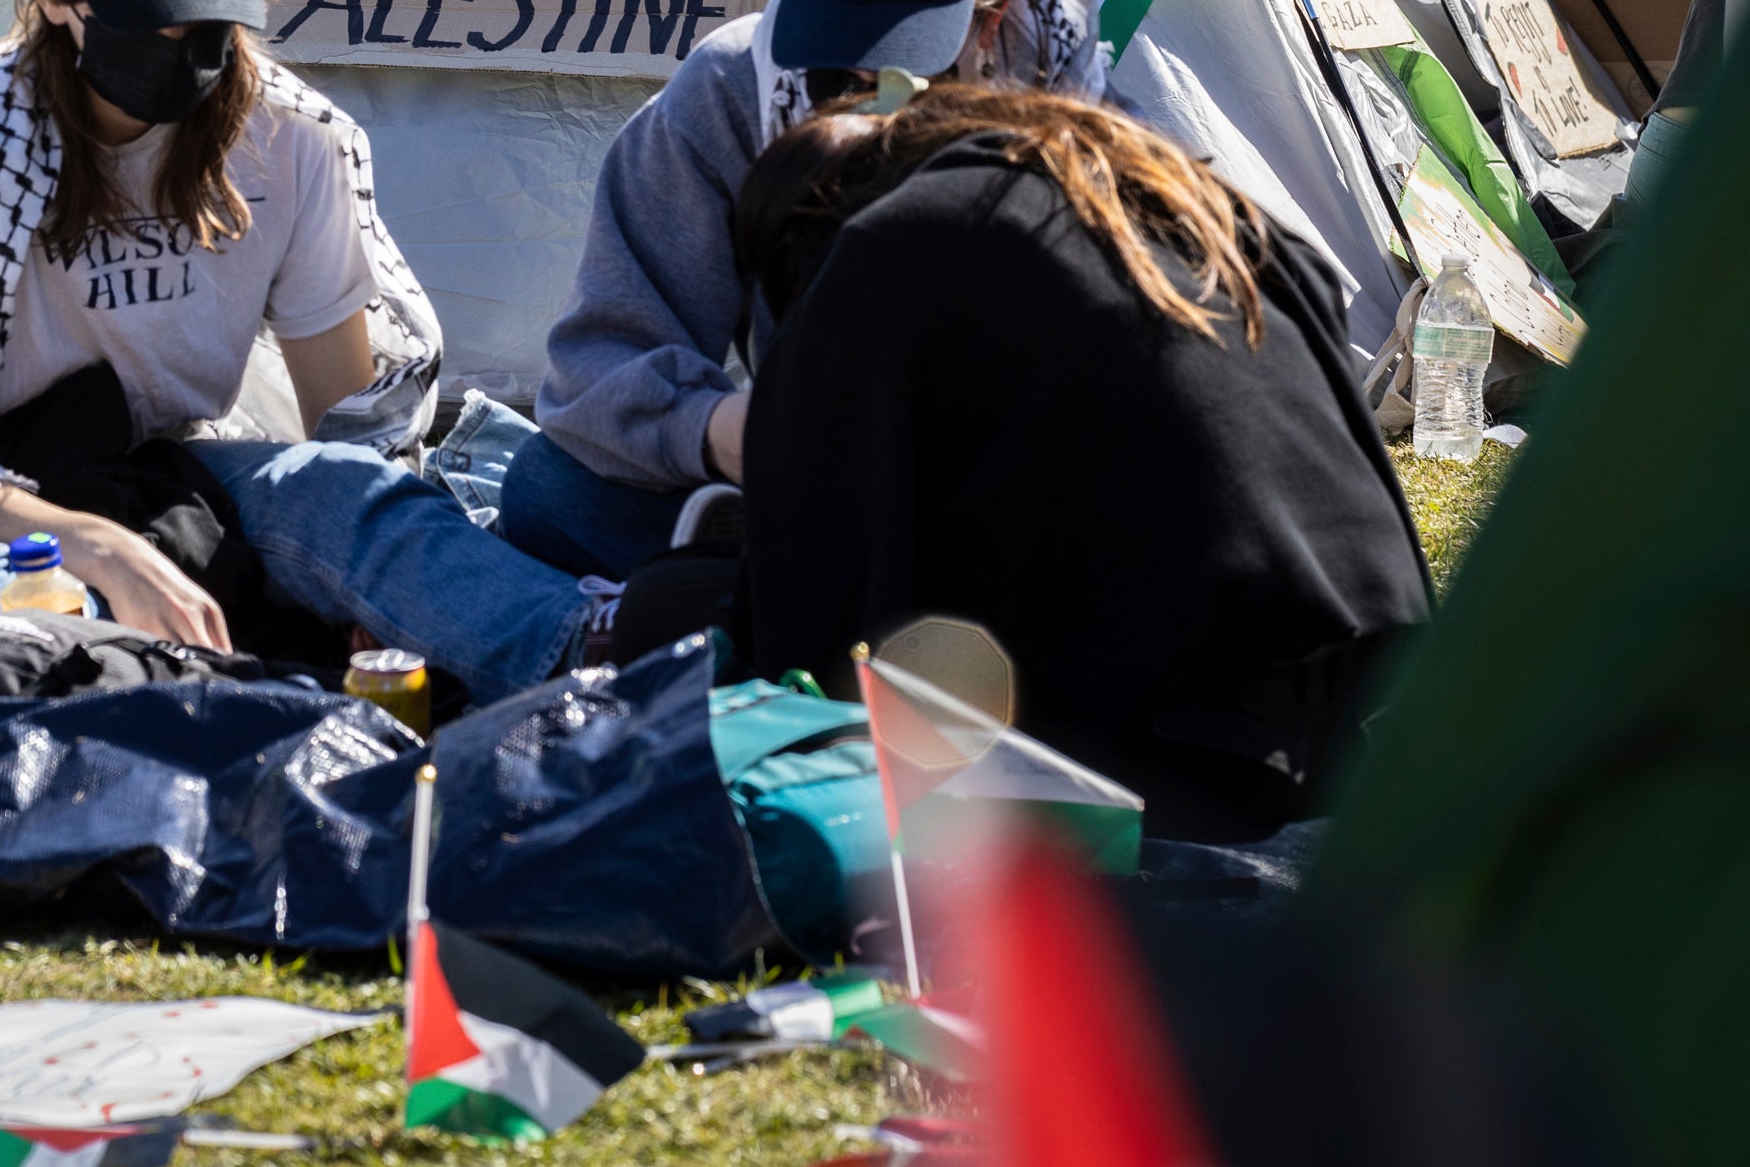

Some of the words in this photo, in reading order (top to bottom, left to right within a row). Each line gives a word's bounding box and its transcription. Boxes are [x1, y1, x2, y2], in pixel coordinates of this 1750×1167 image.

[1321, 0, 1378, 31] GAZA
[33, 220, 216, 272] WILSO
[84, 261, 196, 310] HILL
